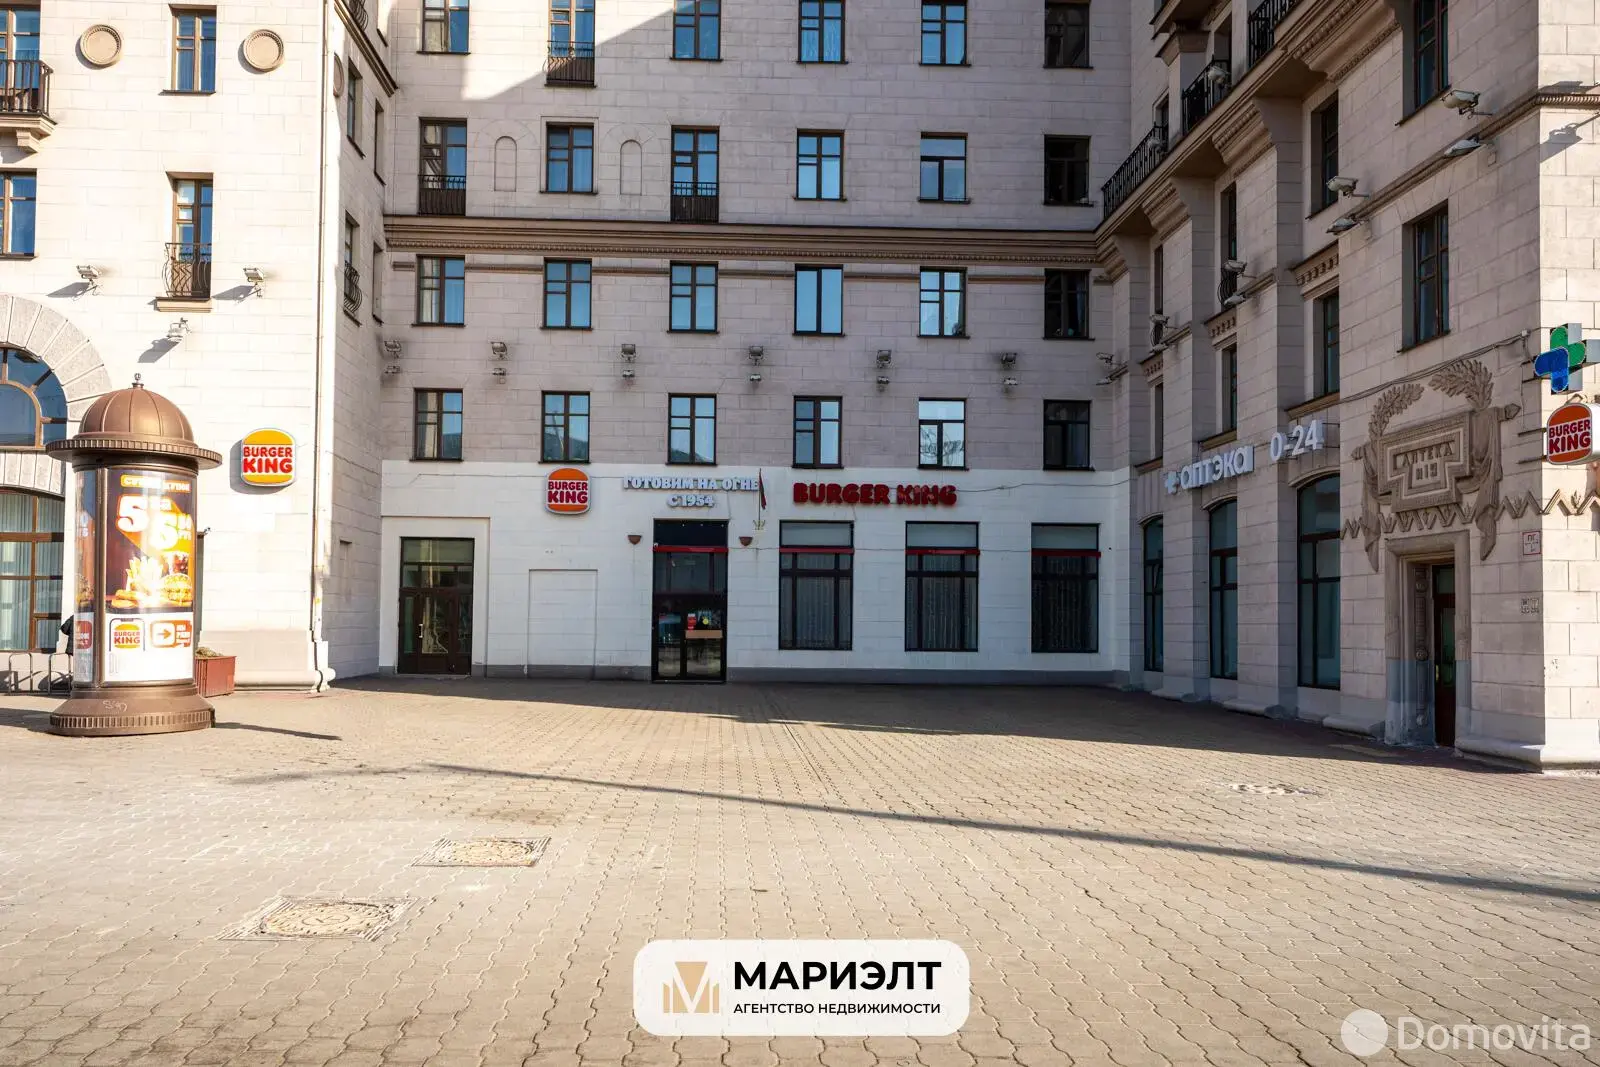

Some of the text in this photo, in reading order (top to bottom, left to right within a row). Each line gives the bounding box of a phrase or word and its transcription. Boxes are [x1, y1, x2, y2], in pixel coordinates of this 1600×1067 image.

[1549, 419, 1591, 439] BURGER
[1269, 419, 1322, 462] 0-24
[1549, 431, 1591, 454] KING
[243, 446, 293, 458] BURGER
[243, 457, 293, 473] KING
[548, 481, 588, 491] BURGER
[623, 477, 760, 492] ГОТОВИМ НА ОГНЕ
[547, 490, 588, 504] KING
[681, 494, 715, 508] 1954
[793, 482, 958, 506] BURGER KING
[113, 636, 141, 645] KING
